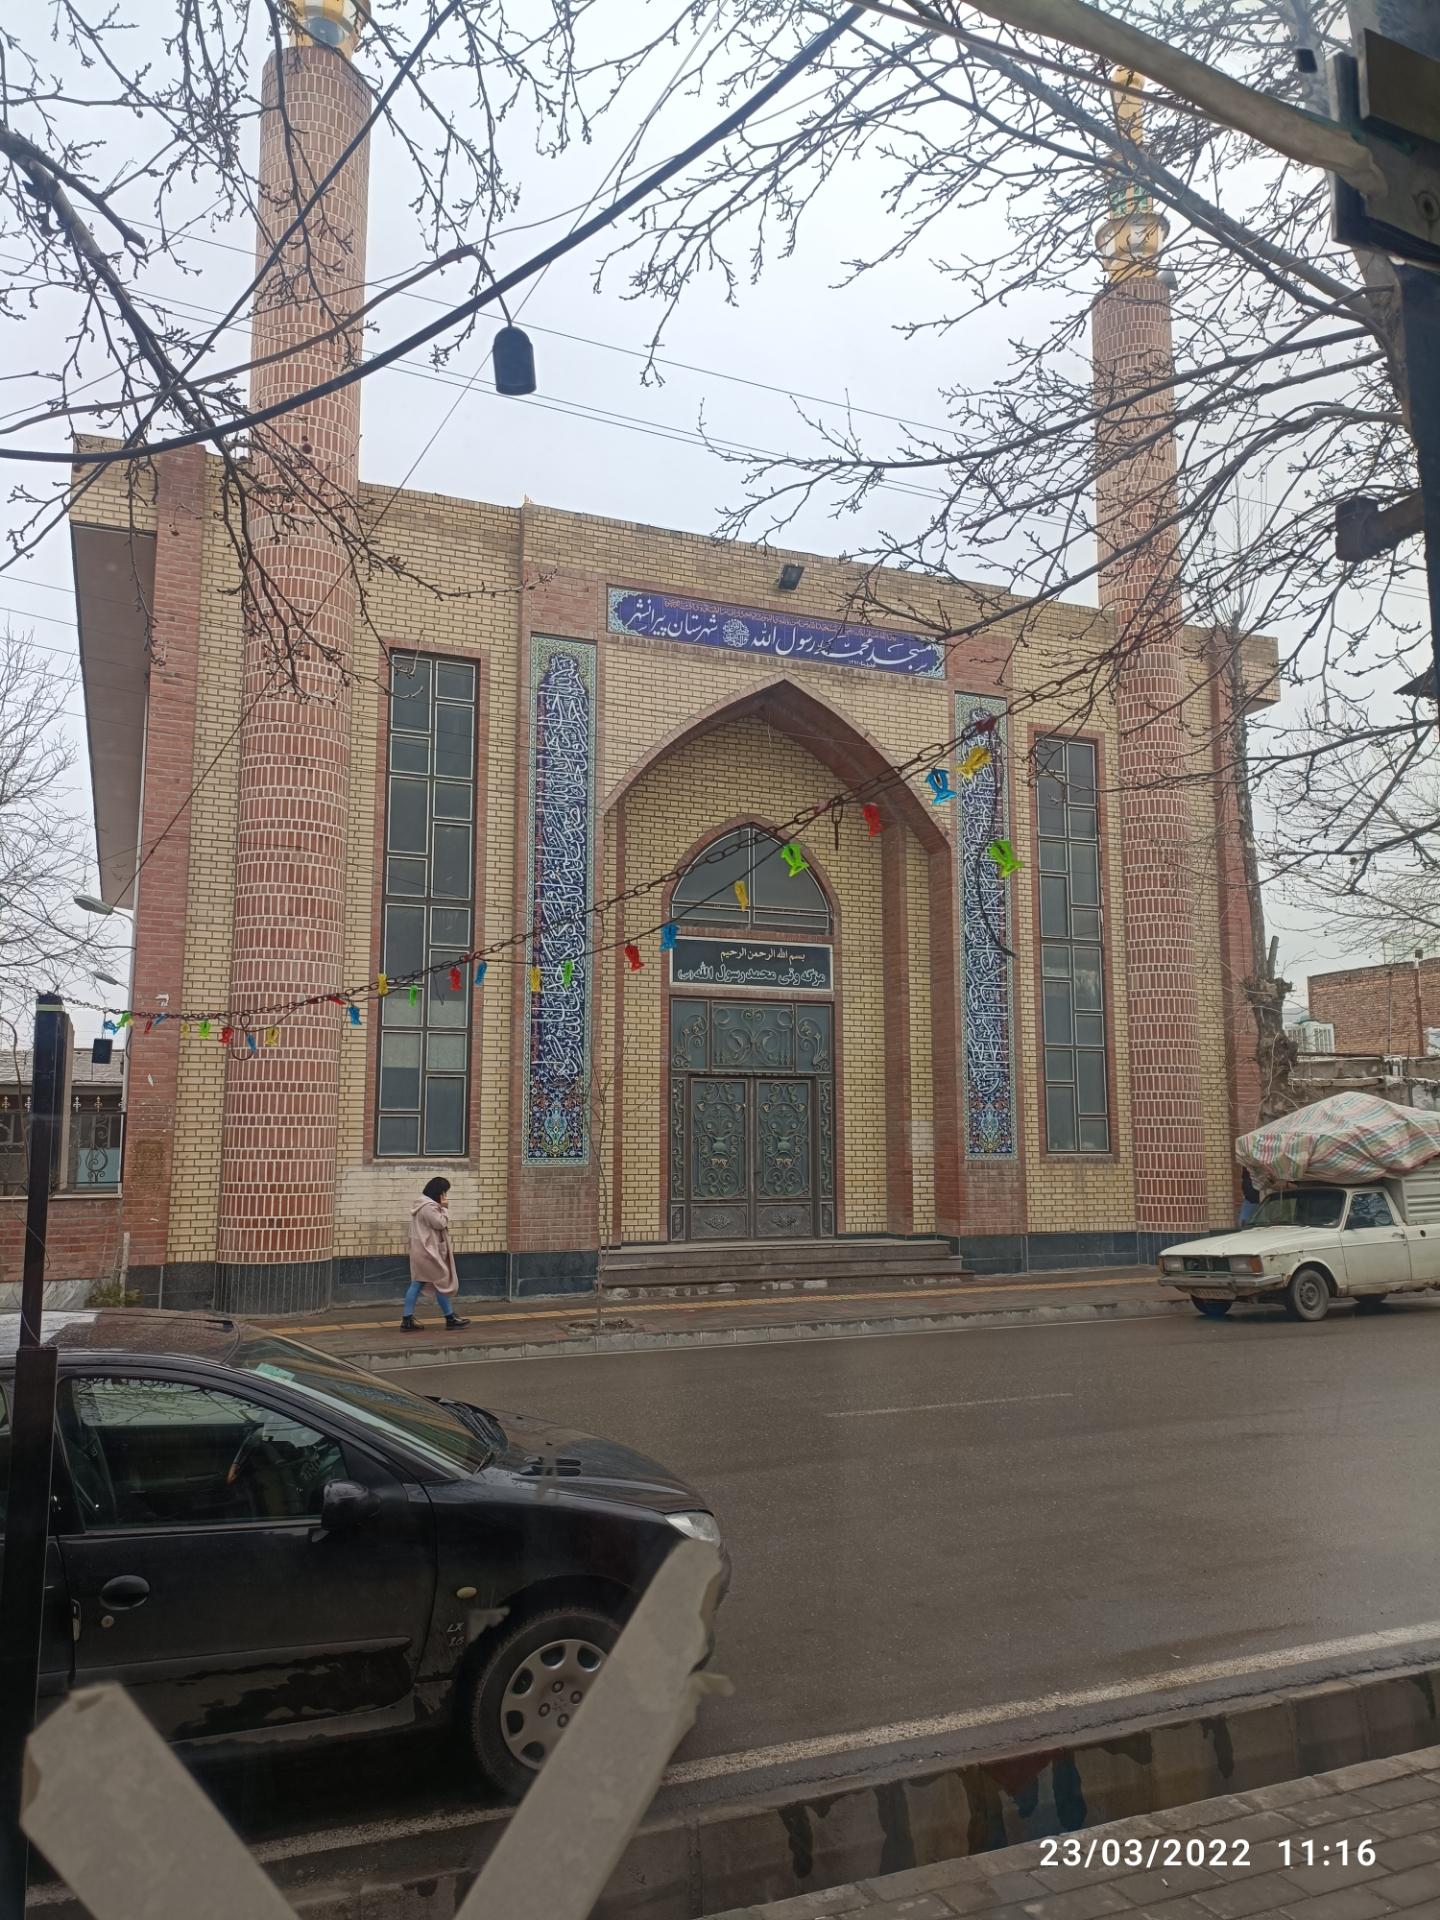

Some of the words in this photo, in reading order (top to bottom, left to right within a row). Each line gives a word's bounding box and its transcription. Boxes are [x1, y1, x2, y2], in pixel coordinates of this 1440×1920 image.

[625, 598, 668, 636] پیرانشهر
[667, 613, 718, 642] شهرستان
[751, 622, 777, 647] الله
[775, 626, 816, 655] رسول
[866, 643, 932, 672] مسجد
[748, 948, 776, 961] الرحمن
[776, 947, 788, 959] الله
[789, 953, 806, 965] بسم
[693, 961, 714, 980] الله
[715, 964, 746, 983] رسول
[746, 968, 777, 980] محمد
